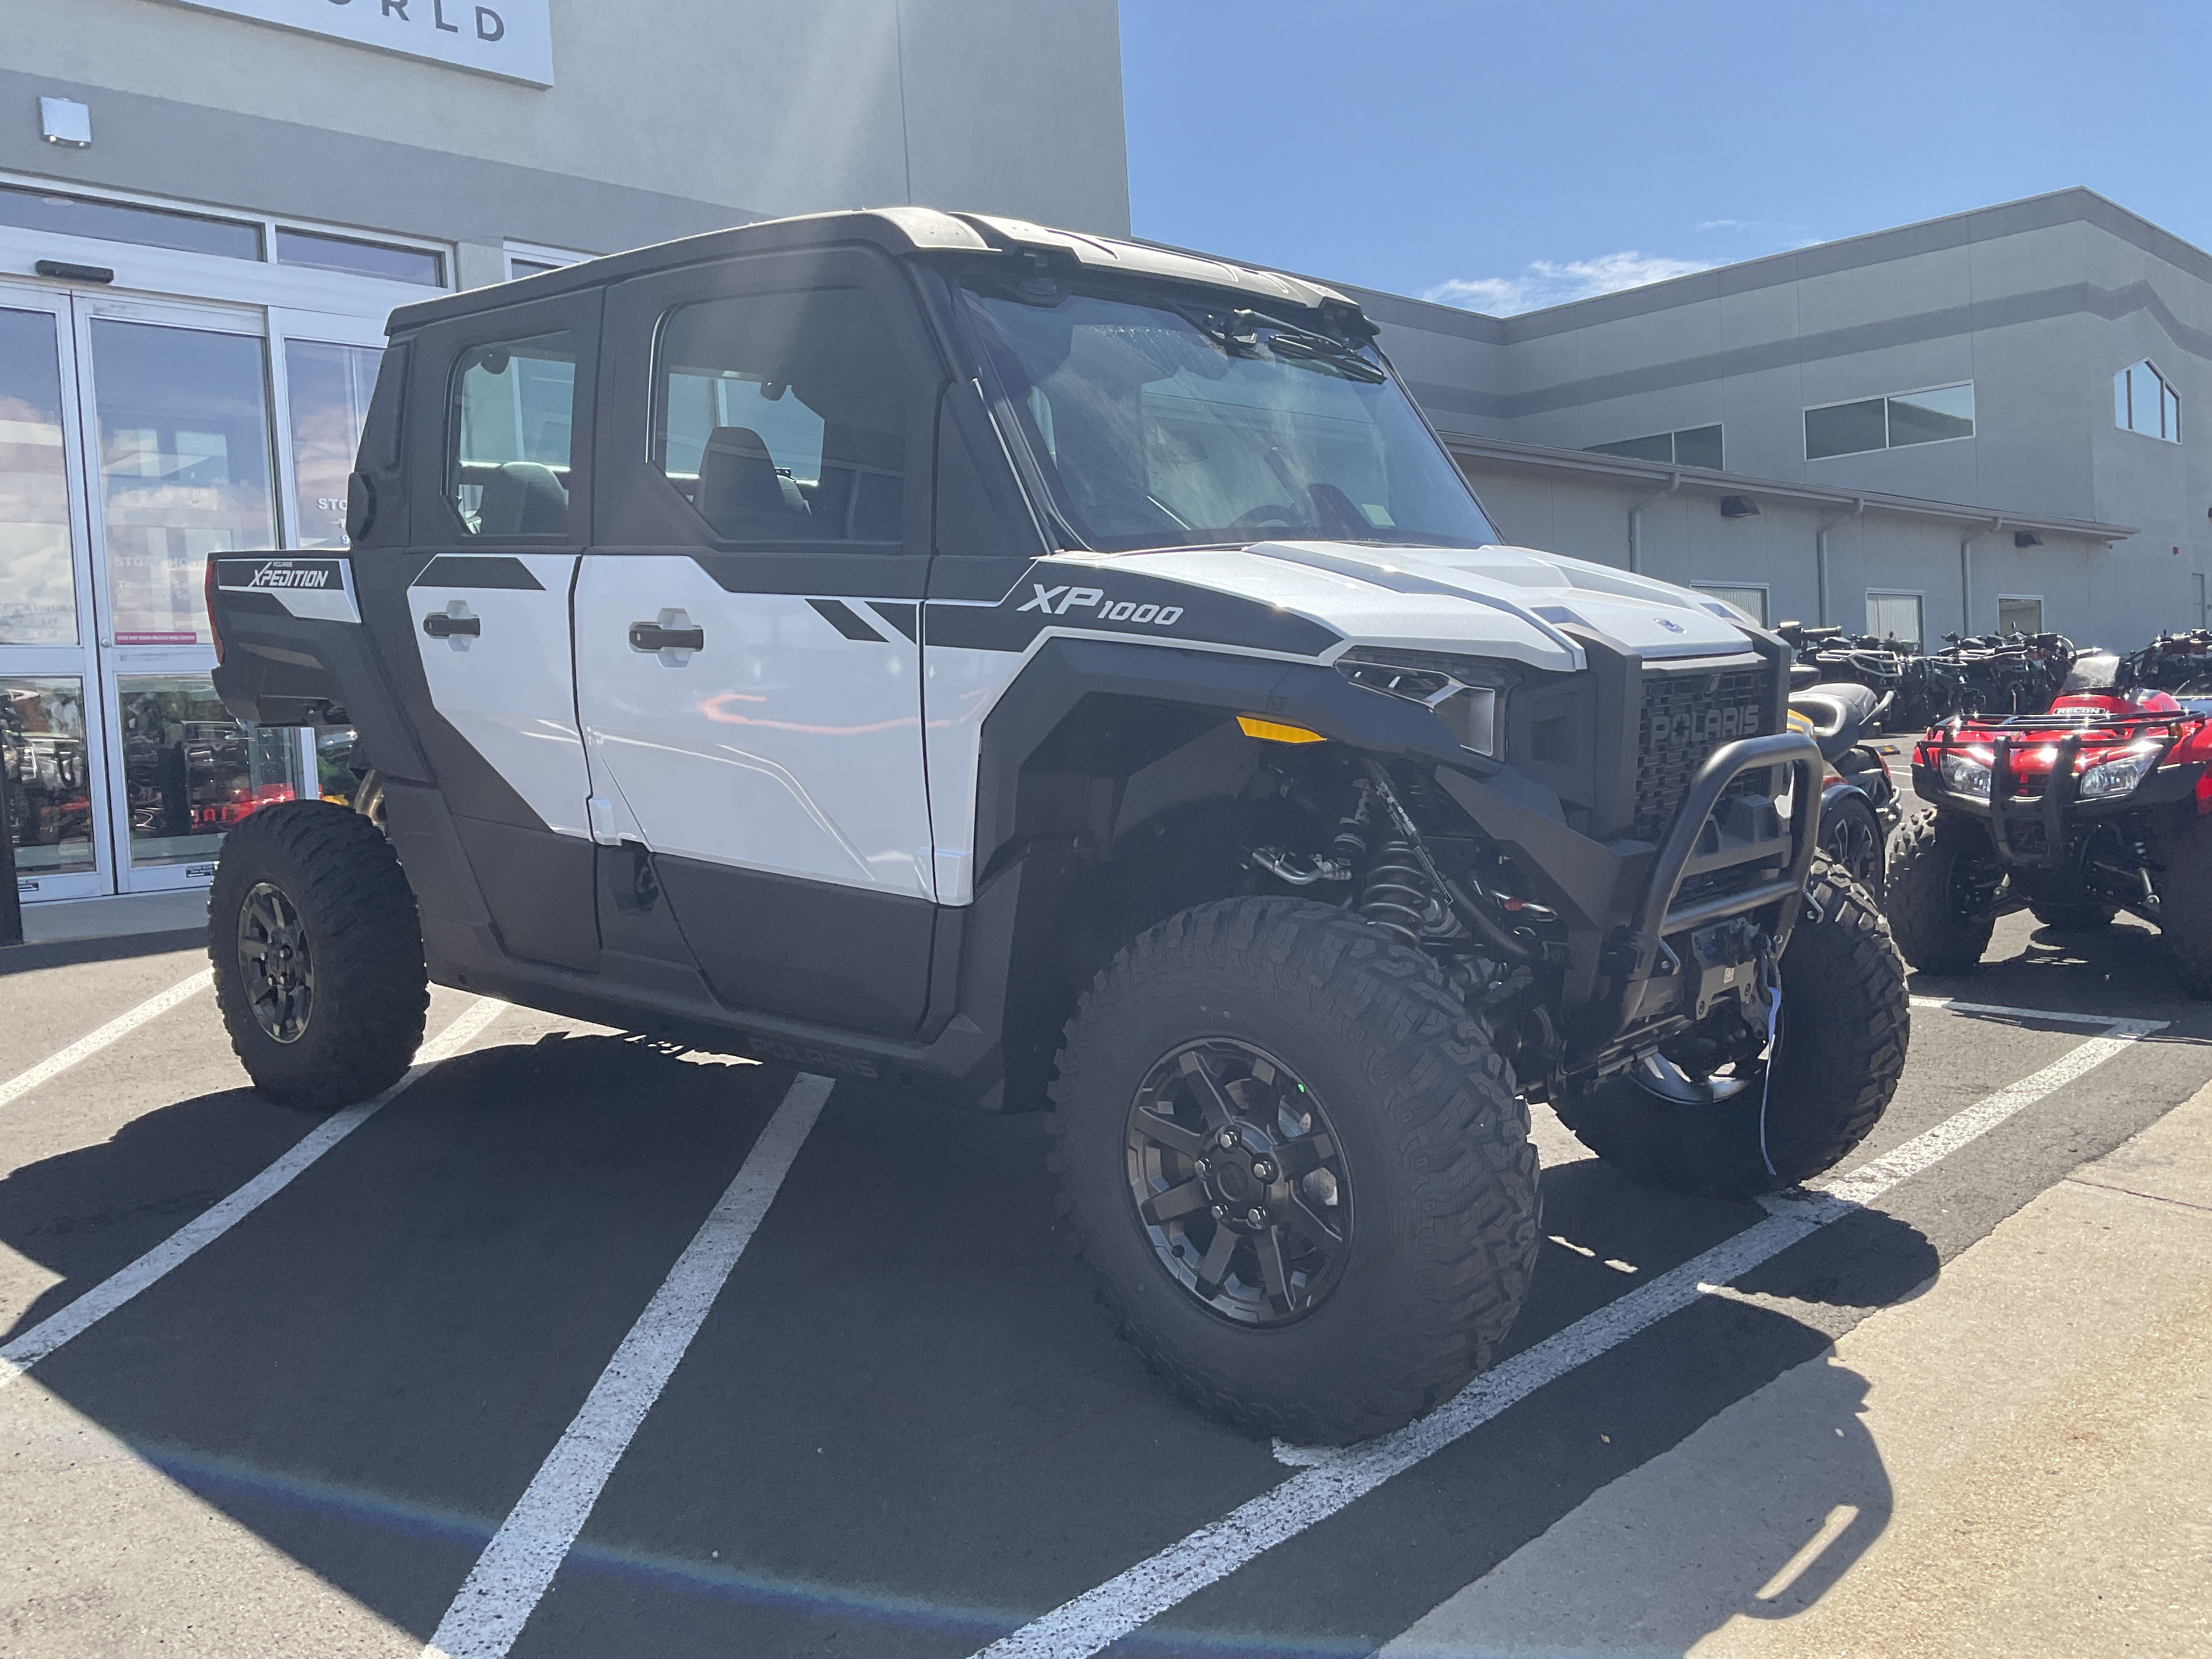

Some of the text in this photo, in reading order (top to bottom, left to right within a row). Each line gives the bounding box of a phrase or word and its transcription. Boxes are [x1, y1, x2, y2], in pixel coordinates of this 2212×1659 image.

[328, 0, 504, 41] RLD
[318, 498, 347, 511] STO
[248, 561, 329, 587] XPEDITION
[1016, 583, 1184, 625] XP 1000
[1650, 704, 1759, 747] POLARIS
[748, 1036, 879, 1080] POLARIS
